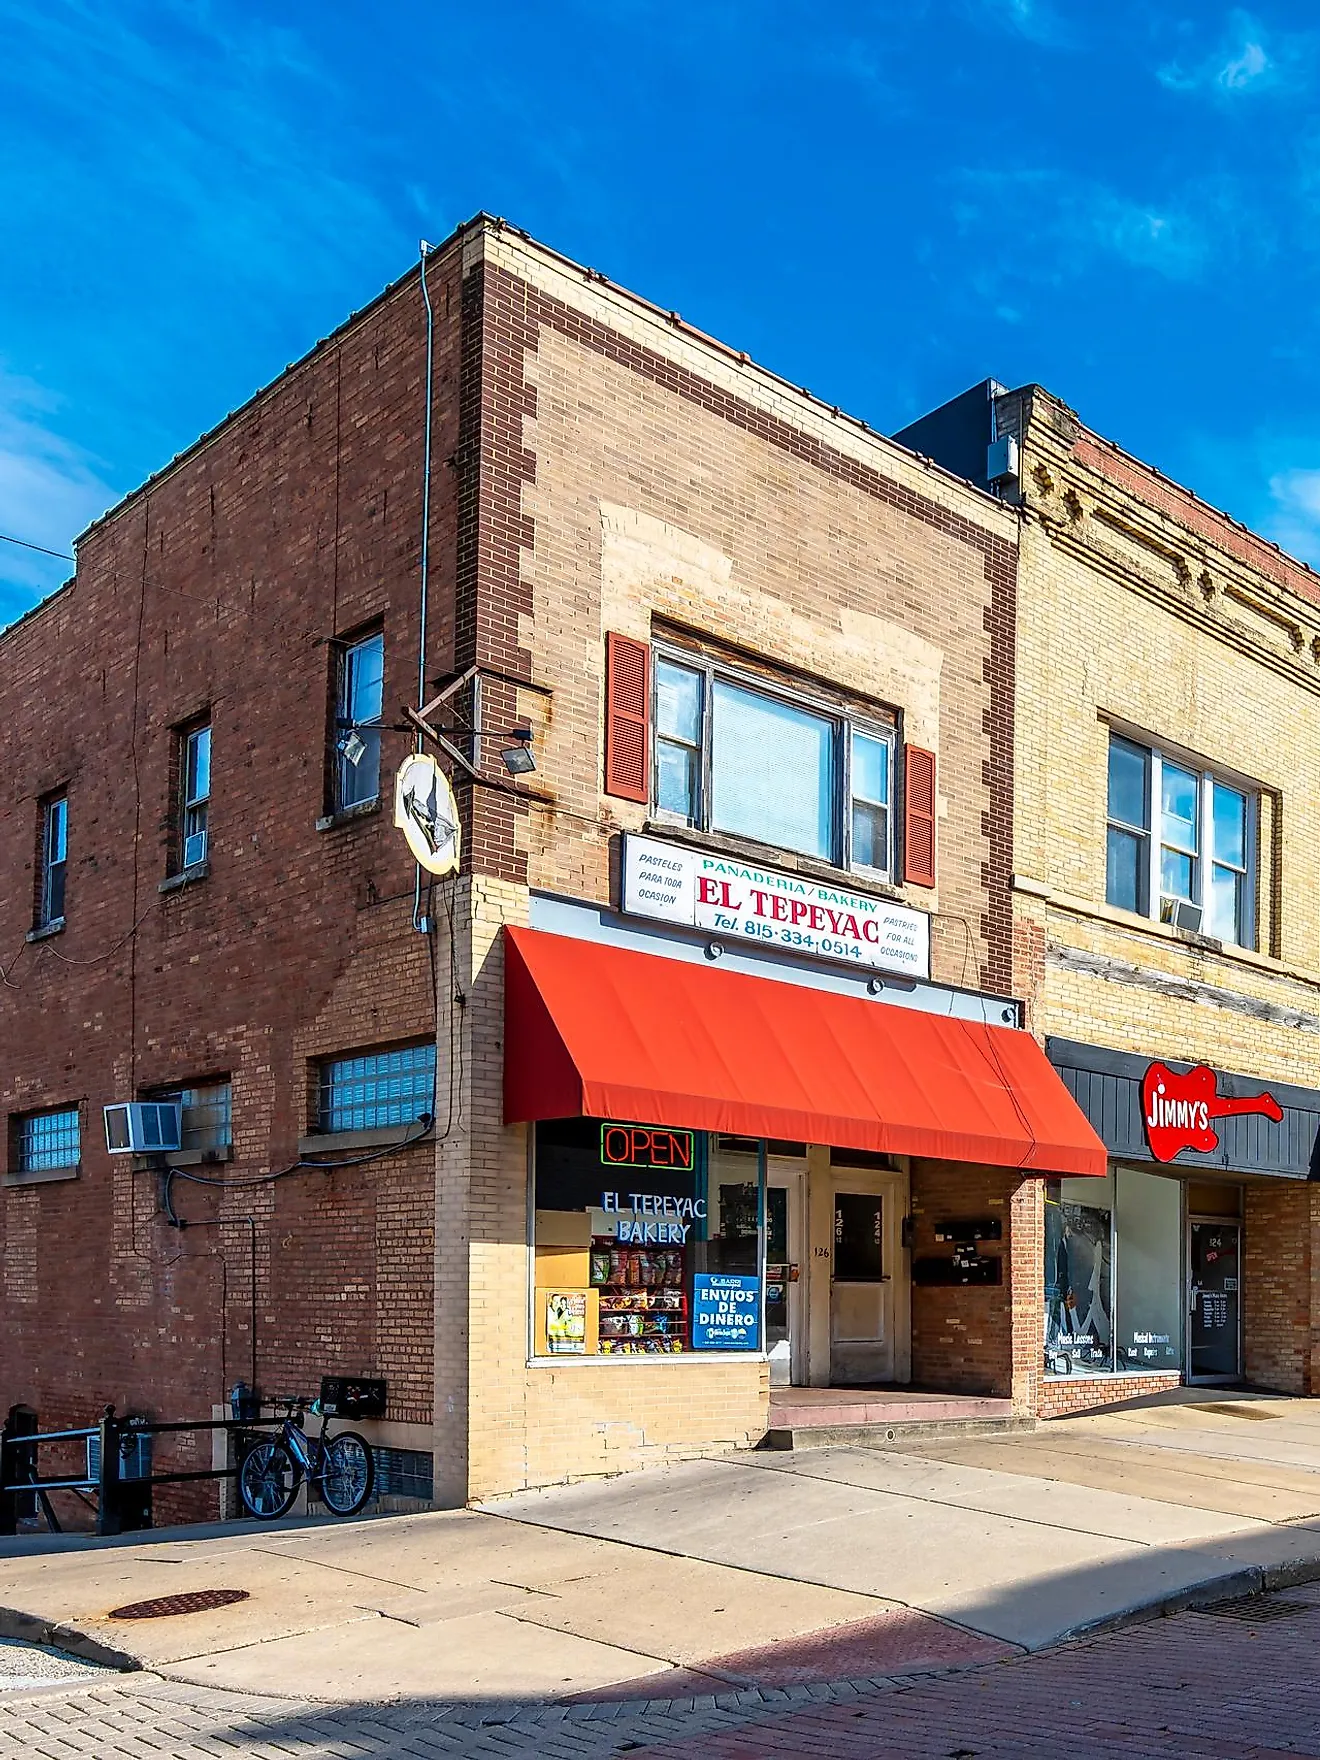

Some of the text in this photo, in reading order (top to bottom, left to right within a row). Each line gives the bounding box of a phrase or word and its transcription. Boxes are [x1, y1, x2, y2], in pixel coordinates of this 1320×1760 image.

[638, 854, 683, 872] PASTELES
[638, 871, 682, 889] PARA TODA
[638, 888, 677, 905] OCASION
[697, 876, 879, 944] EL TEPEYAC
[715, 913, 739, 931] Tel.
[886, 932, 915, 946] FOR ALL
[606, 1128, 690, 1167] OPEN
[603, 1191, 707, 1218] EL TEPEYAC
[617, 1220, 692, 1245] BAKERY
[814, 1247, 830, 1258] 126
[718, 1302, 737, 1314] DE
[699, 1313, 755, 1326] DINERO
